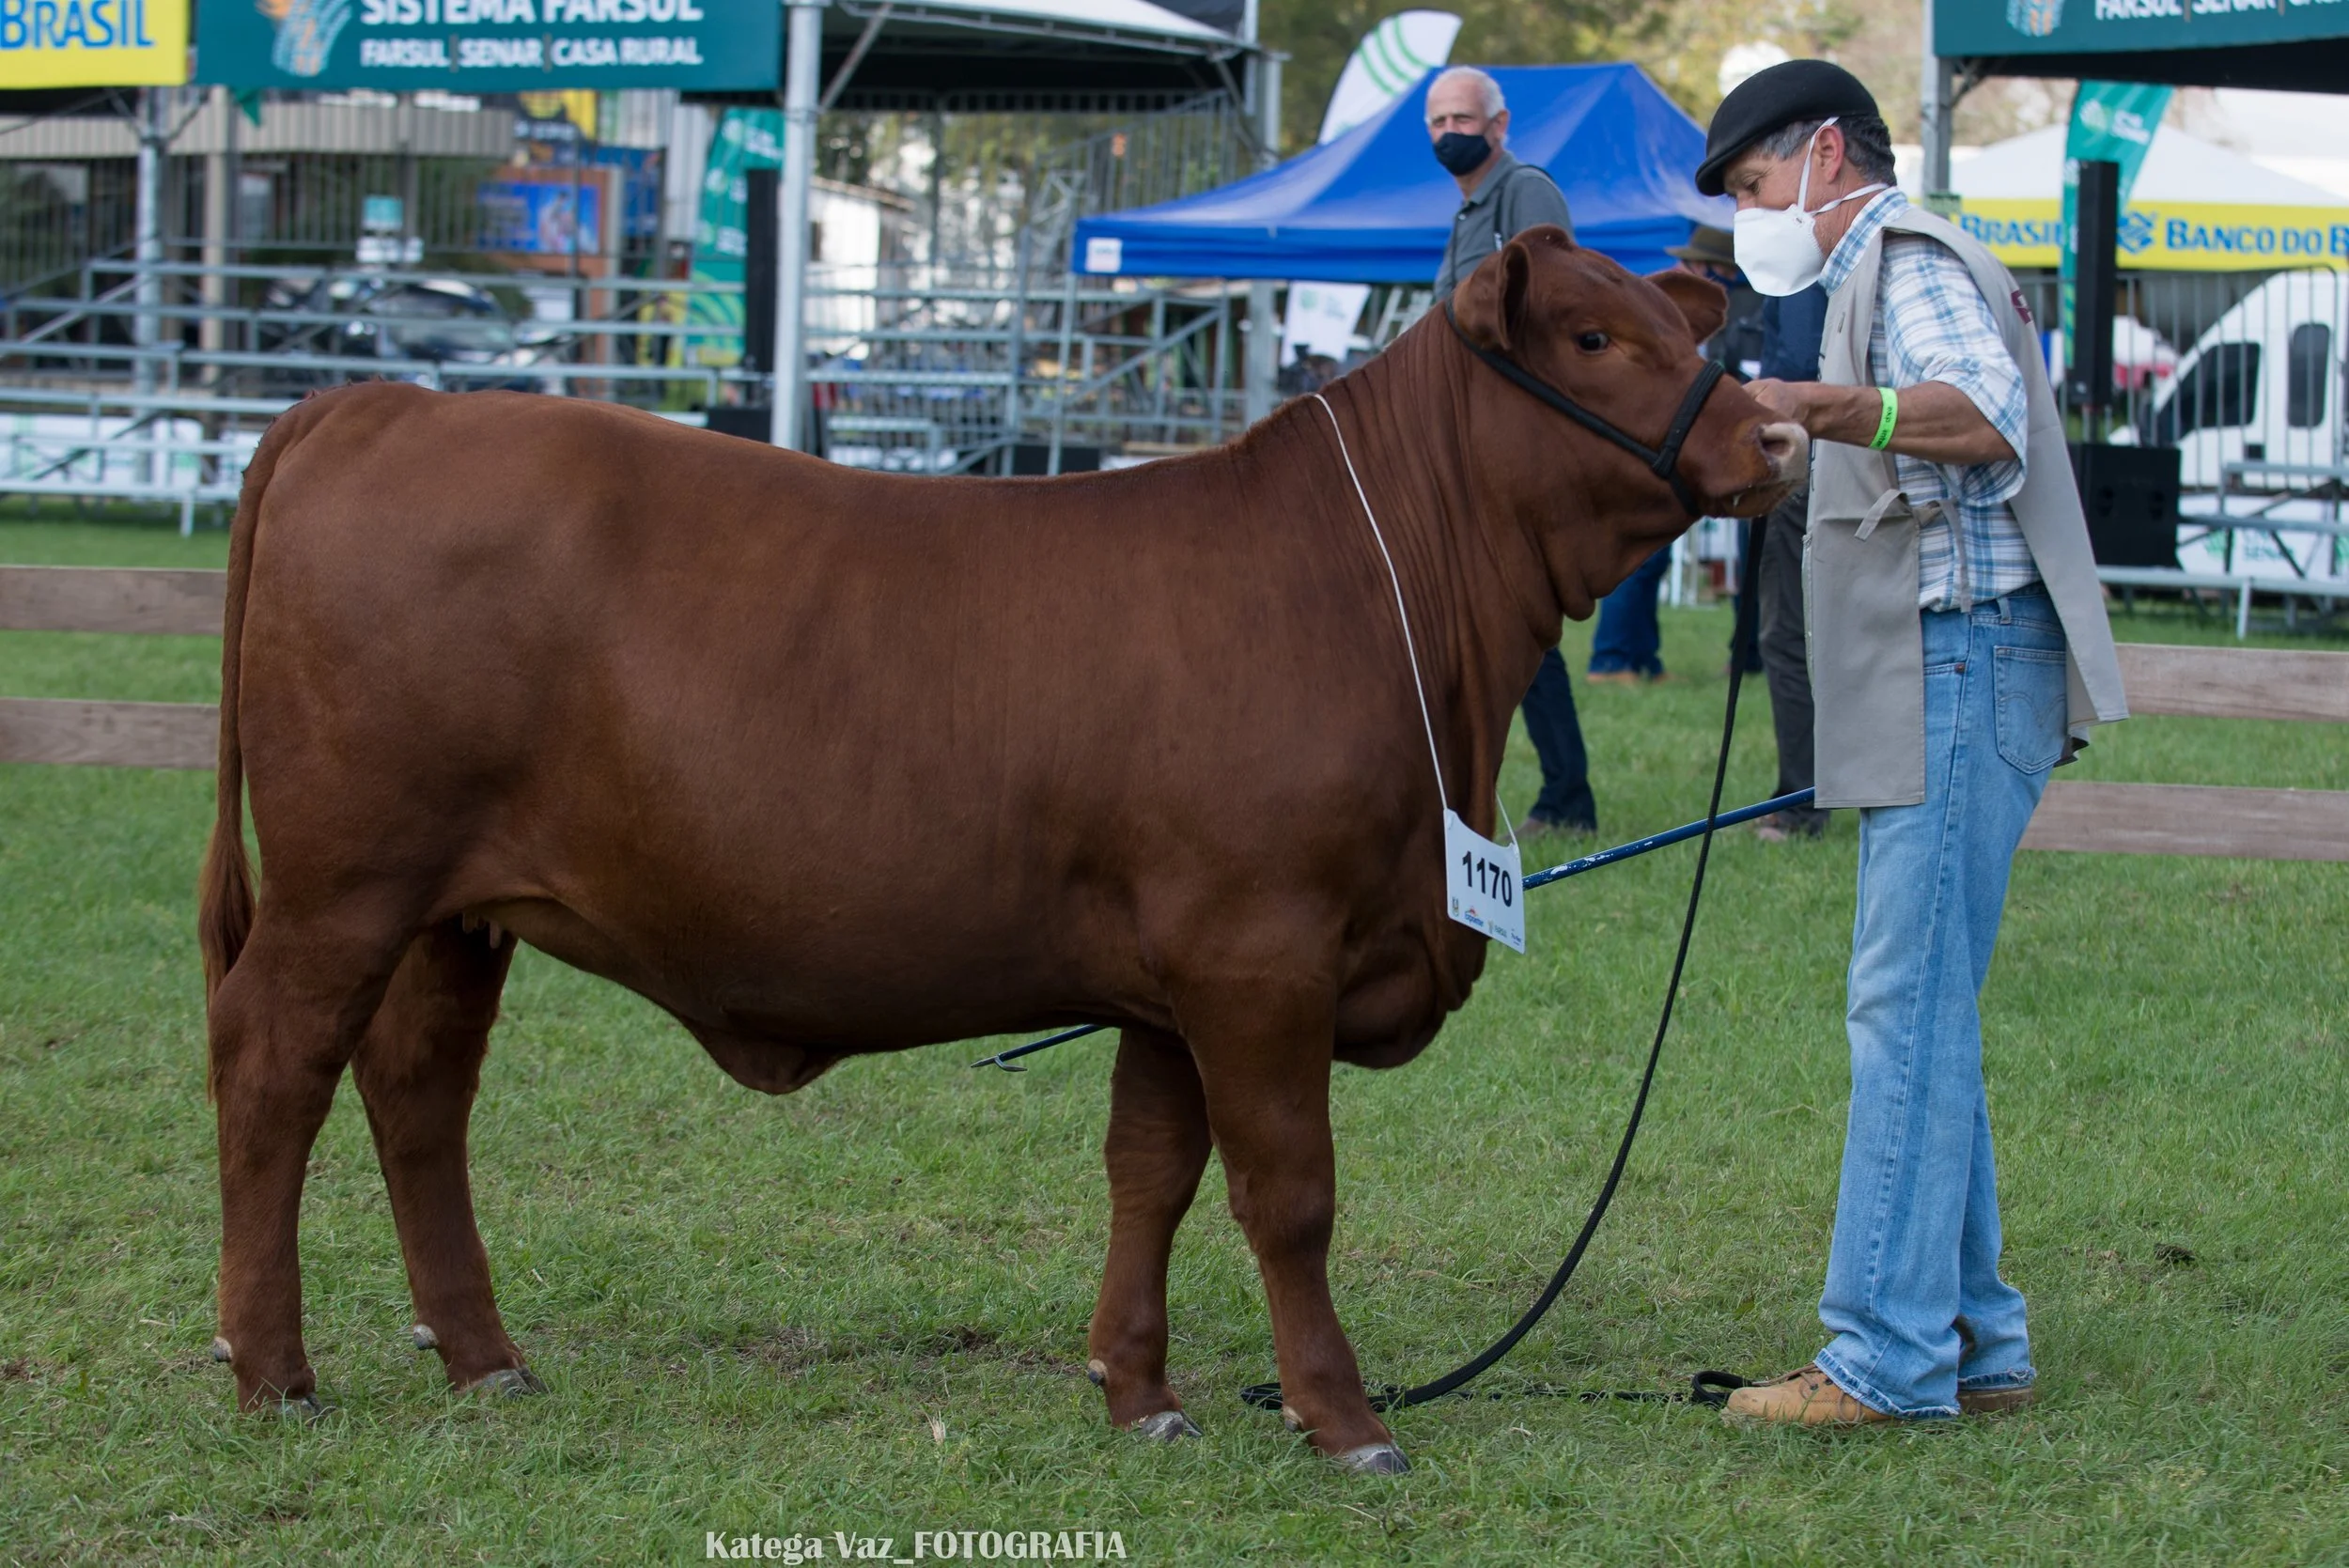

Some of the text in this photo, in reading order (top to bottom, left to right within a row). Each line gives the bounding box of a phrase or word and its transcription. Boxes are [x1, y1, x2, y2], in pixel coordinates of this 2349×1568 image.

[0, 0, 155, 49] BRASIL
[360, 0, 537, 24] SISTEMA
[360, 36, 704, 68] FARSUL SENAR CASA RURAL
[2165, 217, 2276, 255] BANCO
[2280, 225, 2324, 256] DO
[1462, 850, 1513, 908] 1170
